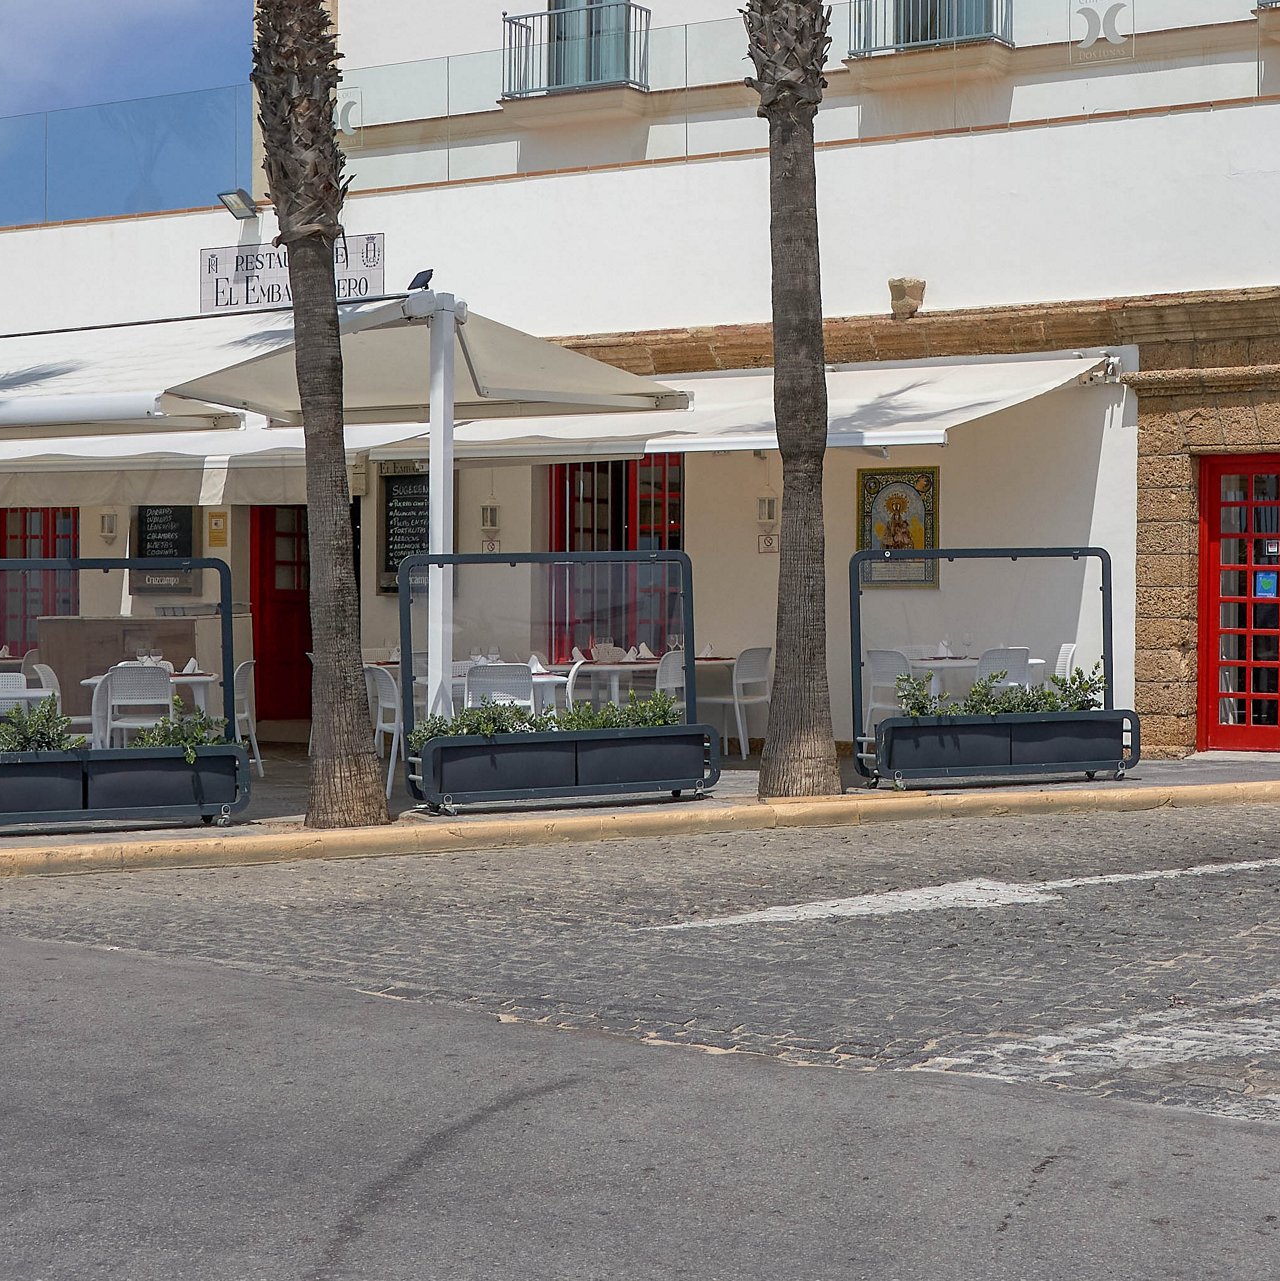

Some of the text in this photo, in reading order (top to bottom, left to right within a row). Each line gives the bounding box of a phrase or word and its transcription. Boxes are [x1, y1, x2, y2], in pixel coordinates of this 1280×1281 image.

[235, 246, 346, 272] RESTAUE
[215, 275, 369, 307] EL EMBAERO
[145, 575, 180, 586] Cruzcampo
